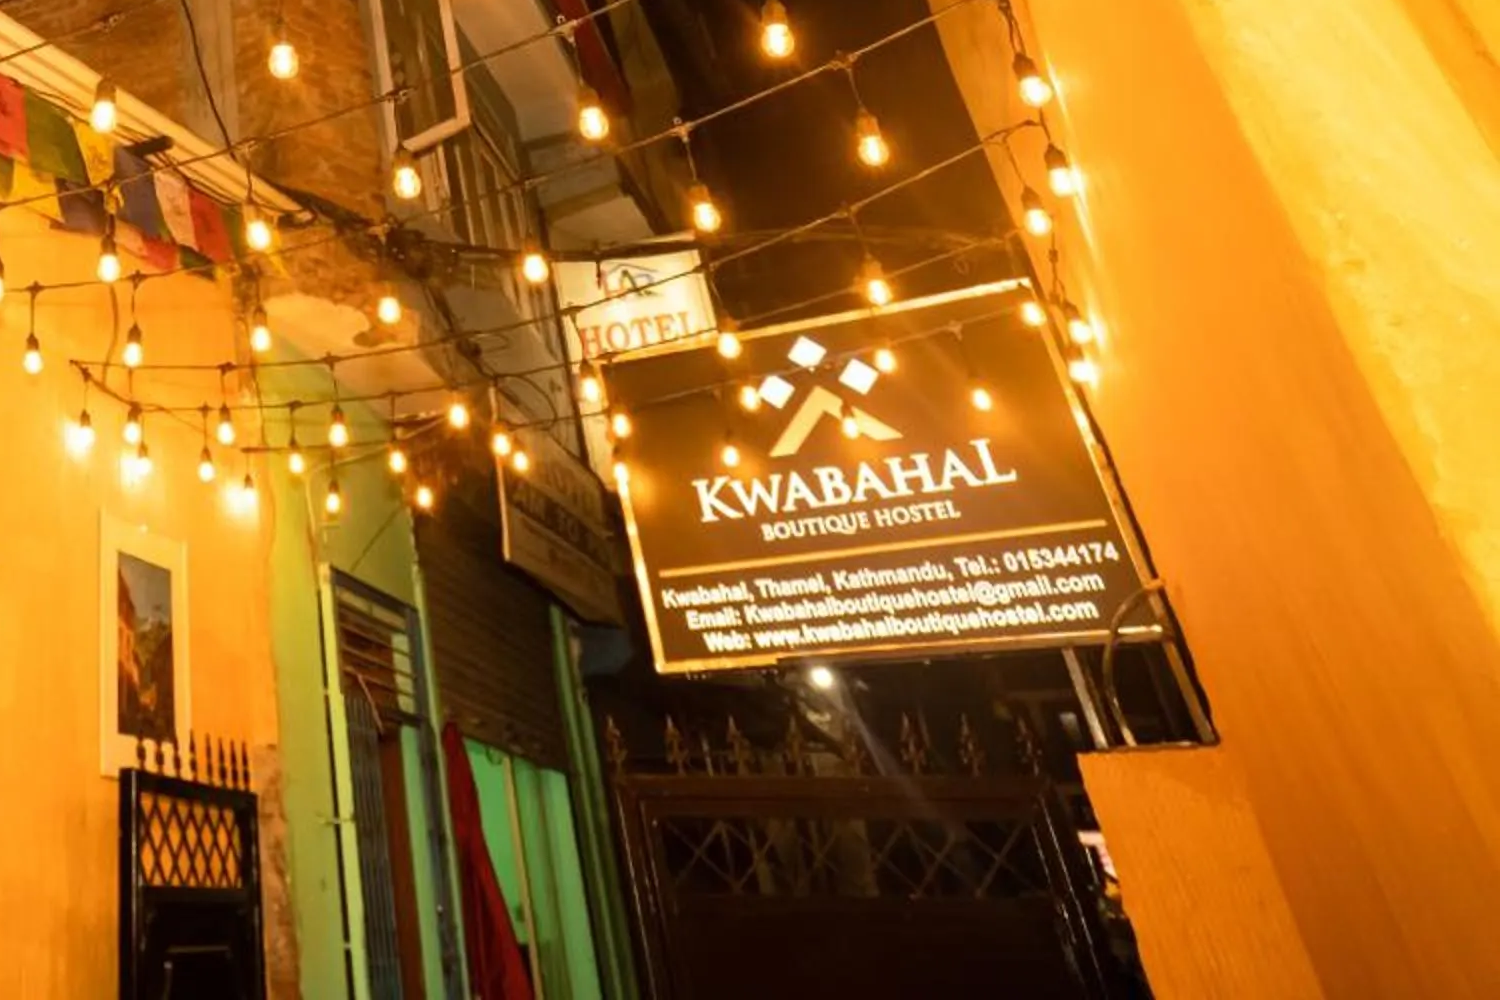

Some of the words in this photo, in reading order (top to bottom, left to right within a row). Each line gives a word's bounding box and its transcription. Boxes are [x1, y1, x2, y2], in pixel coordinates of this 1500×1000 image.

[579, 311, 692, 359] HOTEL
[691, 438, 1017, 522] KWABAHAL
[761, 510, 872, 541] BOUTIQUE
[874, 500, 961, 528] HOSTEL
[661, 581, 754, 608] Kwabahal,
[754, 573, 831, 599] Thamel,
[832, 560, 954, 590] Kathmandu,
[685, 607, 742, 630] Email:
[703, 630, 752, 653] Web:
